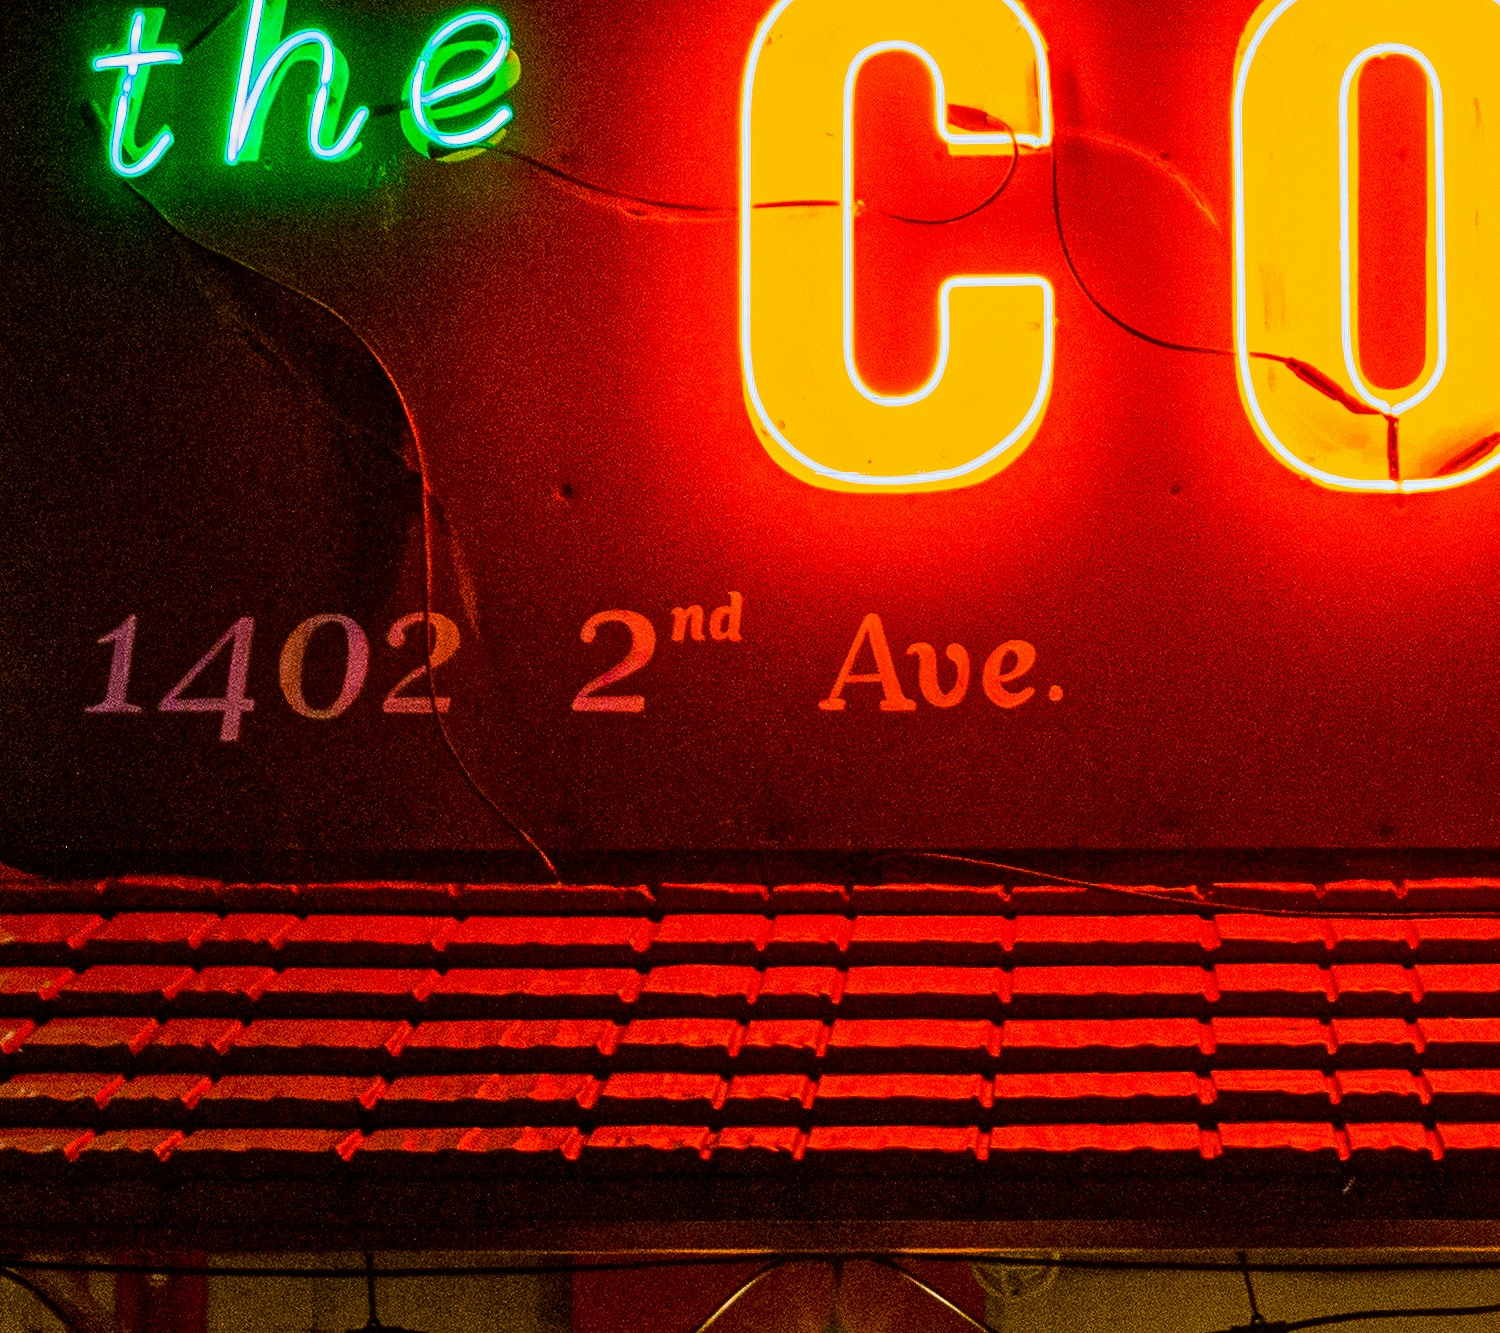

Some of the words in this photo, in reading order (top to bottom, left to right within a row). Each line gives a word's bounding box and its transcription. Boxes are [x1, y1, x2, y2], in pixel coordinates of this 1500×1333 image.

[92, 0, 520, 176] the
[83, 612, 463, 742] 1402
[570, 592, 744, 714] 2nd
[818, 612, 1064, 712] Ave.
